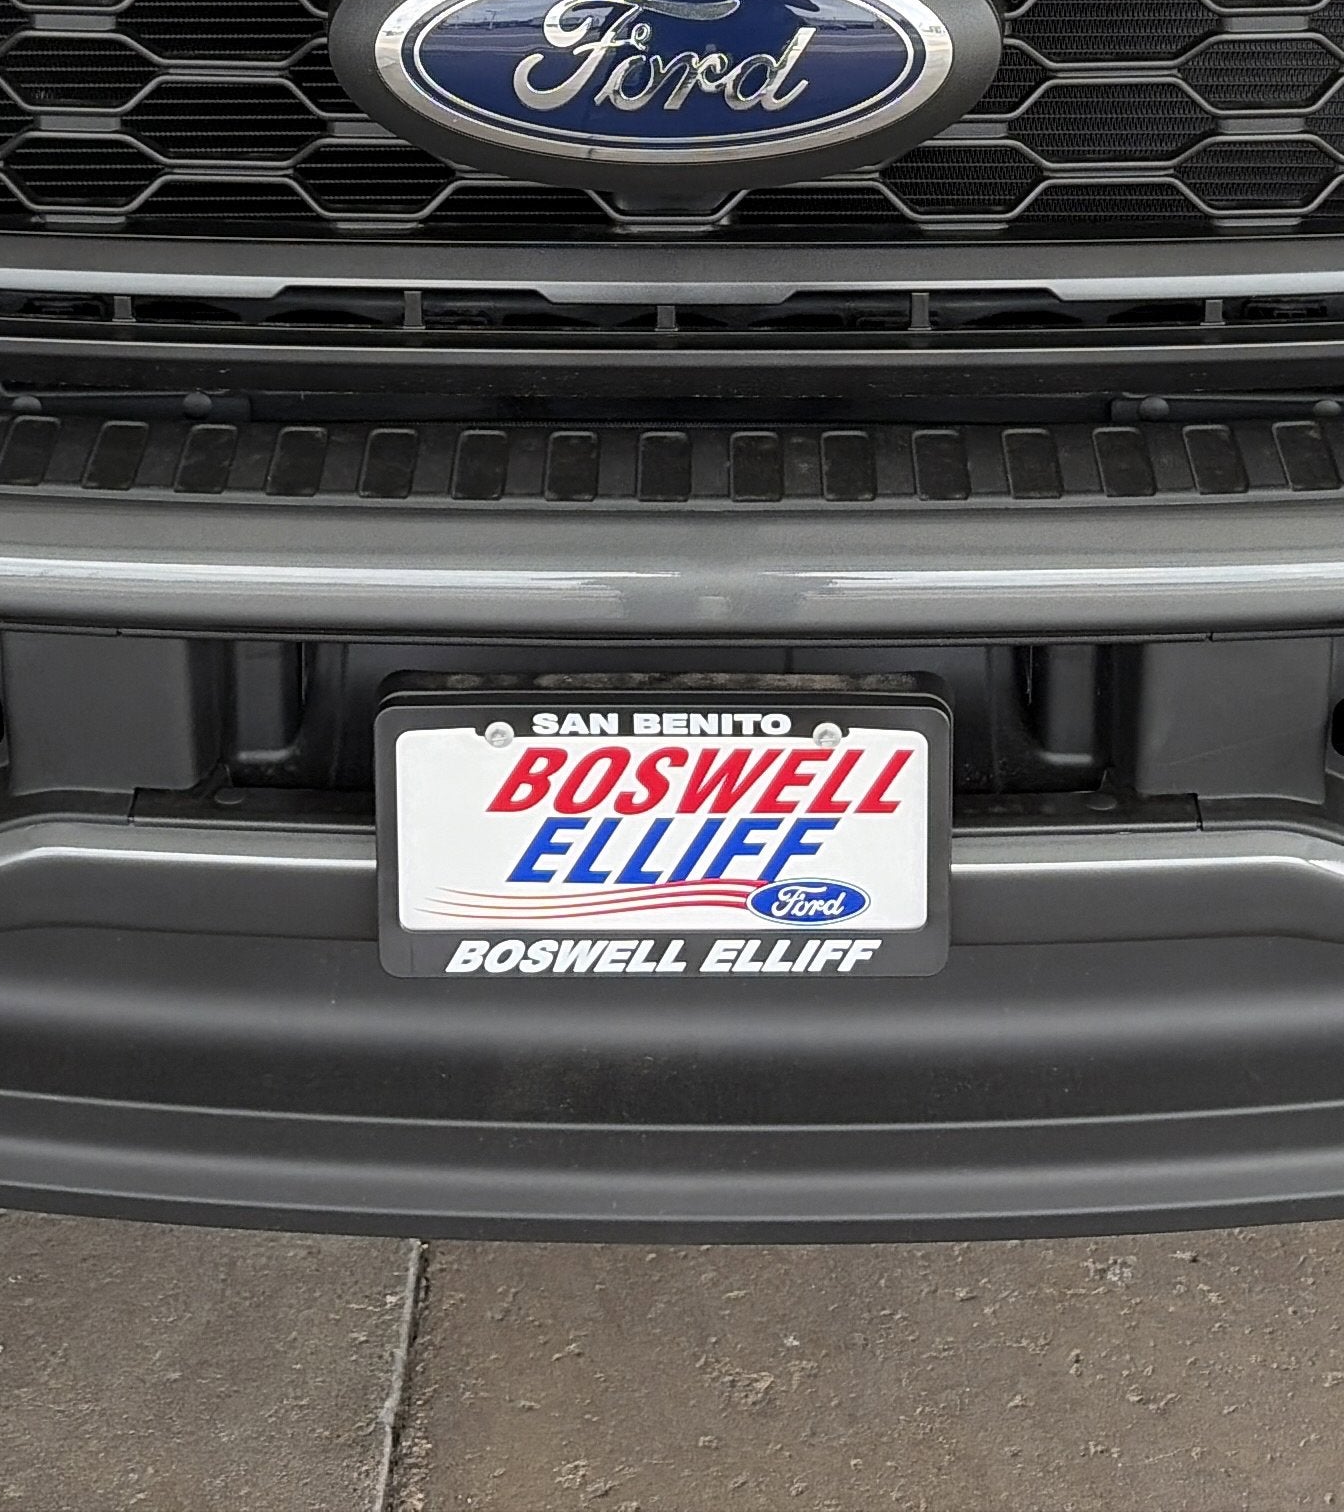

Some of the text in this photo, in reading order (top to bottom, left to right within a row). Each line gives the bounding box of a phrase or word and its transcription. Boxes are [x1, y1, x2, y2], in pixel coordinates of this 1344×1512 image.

[531, 713, 793, 736] SAN BENITO
[485, 745, 915, 815] BOSWELL
[505, 816, 843, 885] ELLIFF
[770, 884, 847, 919] Ford
[444, 938, 883, 974] BOSWELL ELLIFF
